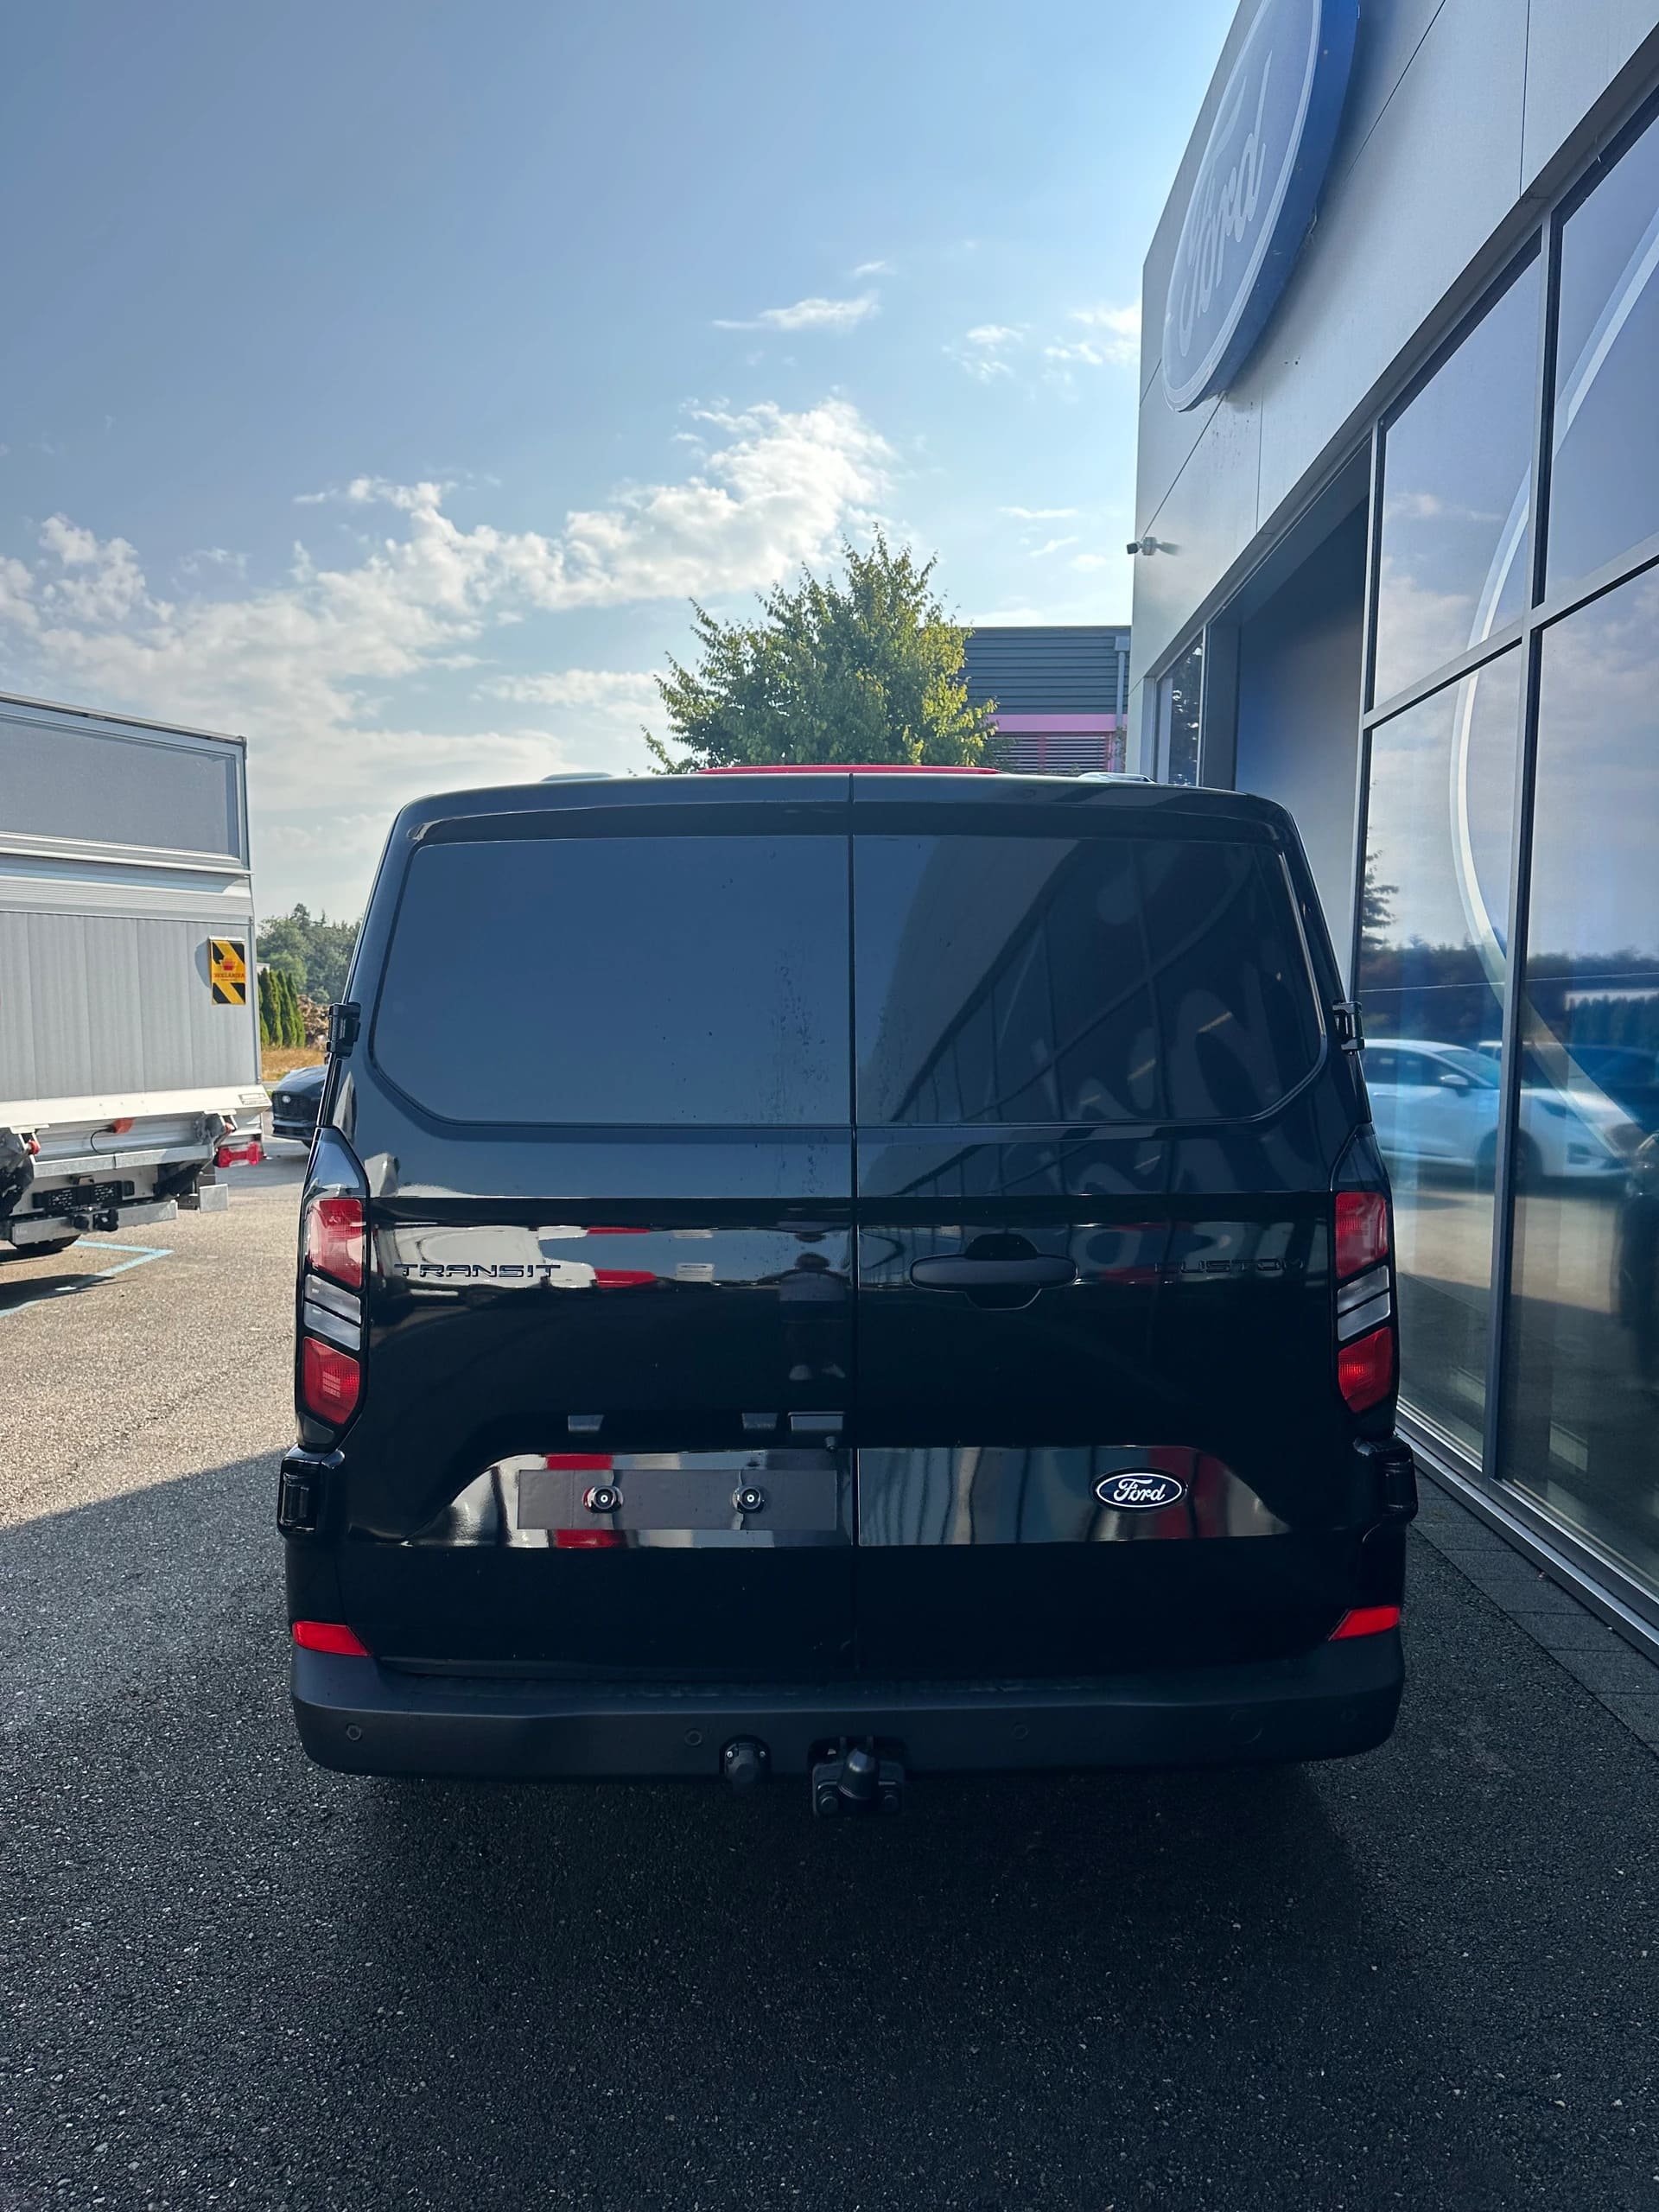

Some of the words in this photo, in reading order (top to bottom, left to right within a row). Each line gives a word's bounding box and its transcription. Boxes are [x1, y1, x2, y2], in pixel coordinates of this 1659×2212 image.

[1179, 49, 1272, 357] Ford
[394, 1263, 562, 1278] TRANSIT
[1113, 1478, 1166, 1502] Ford
